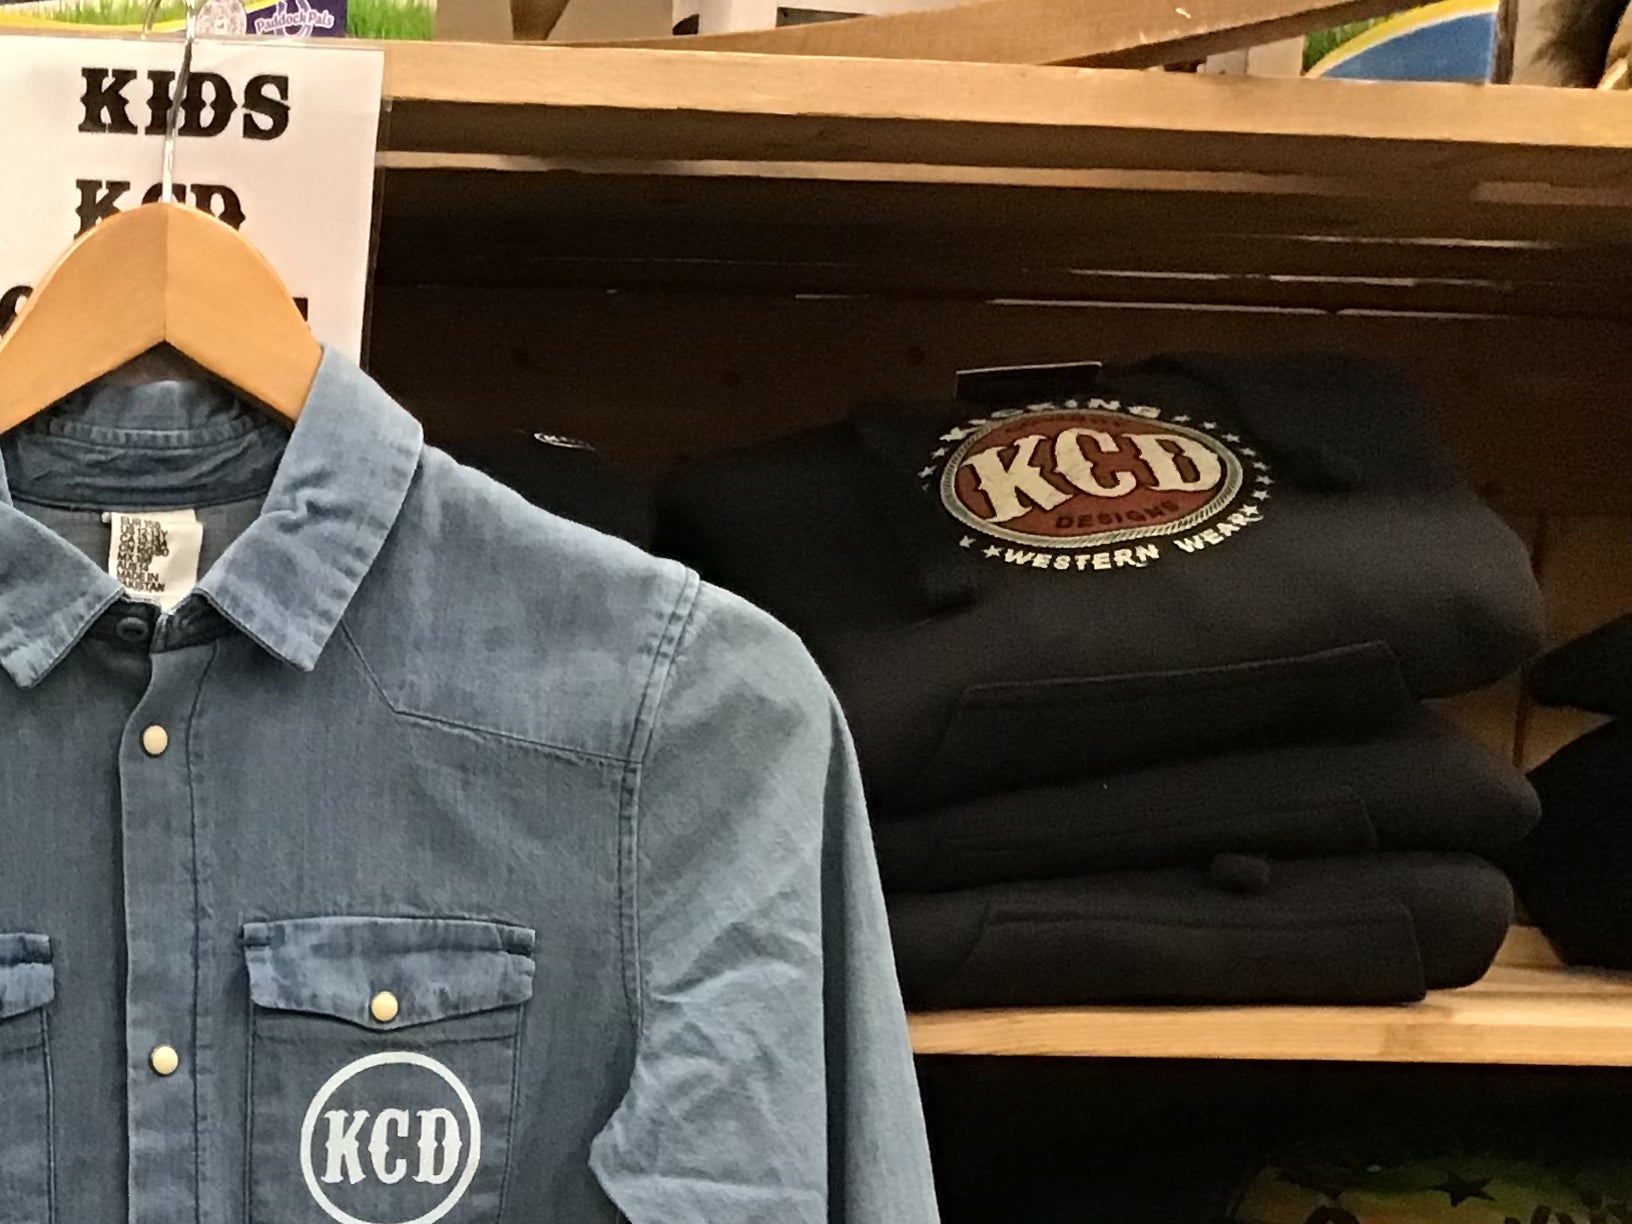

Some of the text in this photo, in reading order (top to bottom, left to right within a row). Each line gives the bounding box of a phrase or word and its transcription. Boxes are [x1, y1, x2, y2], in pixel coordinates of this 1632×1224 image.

[255, 9, 335, 34] Paddock Pals
[78, 67, 291, 141] KIDS
[960, 428, 1222, 523] KCD
[1003, 511, 1266, 571] WESTERN WEAR
[1055, 500, 1180, 530] DESIGNS
[147, 573, 159, 582] IN
[321, 1107, 462, 1184] KCD
